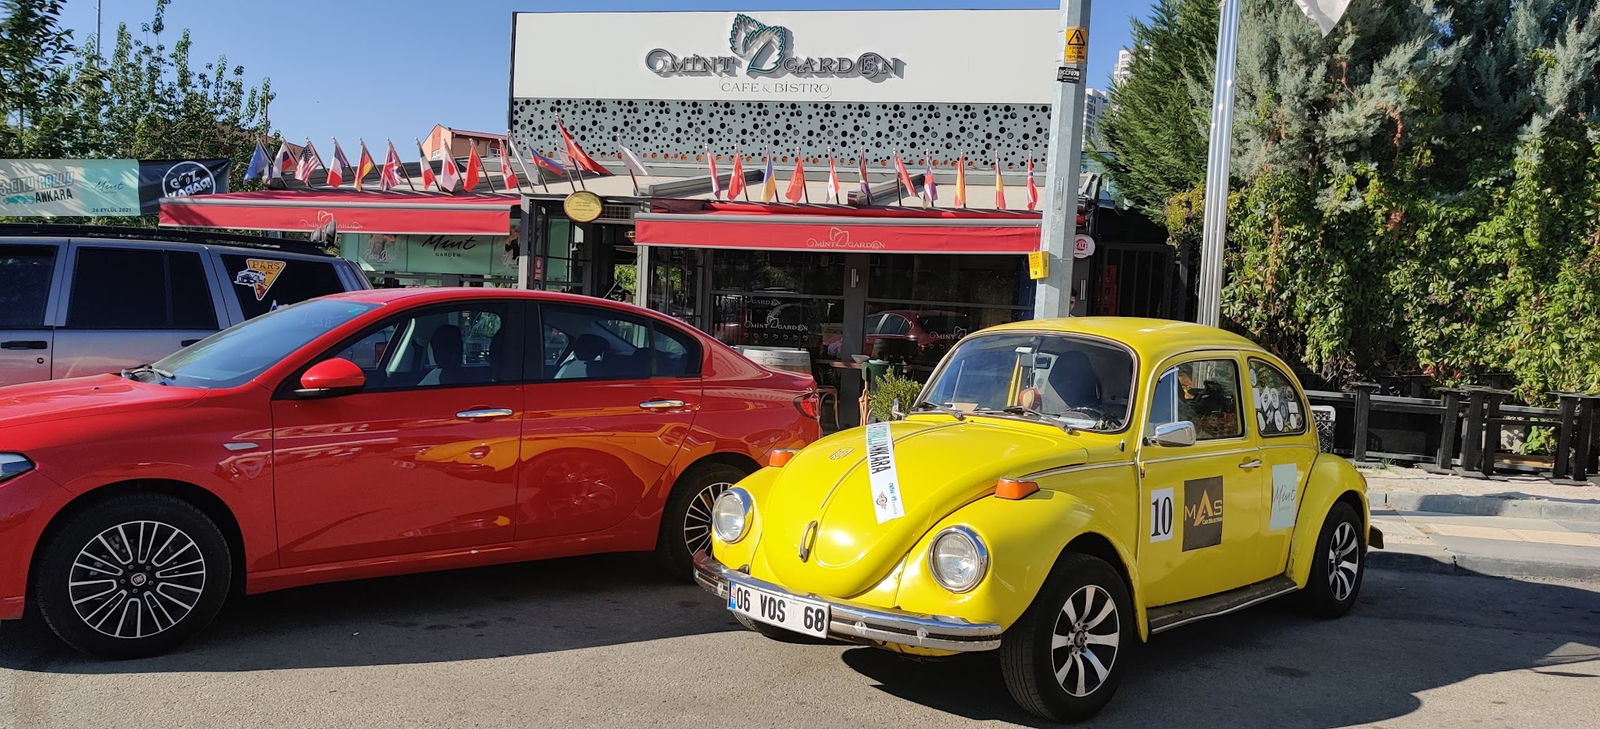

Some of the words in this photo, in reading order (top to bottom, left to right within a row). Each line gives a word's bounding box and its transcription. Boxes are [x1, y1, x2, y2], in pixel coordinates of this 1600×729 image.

[783, 52, 897, 78] GARDEN
[720, 80, 759, 93] CAFE
[35, 188, 73, 204] ANKARA
[252, 261, 280, 270] PARS
[778, 323, 808, 331] GARDEN
[1151, 496, 1173, 537] 10
[1184, 488, 1223, 527] MAS
[736, 586, 751, 612] 06
[760, 593, 786, 623] VOS
[803, 605, 825, 632] 68
